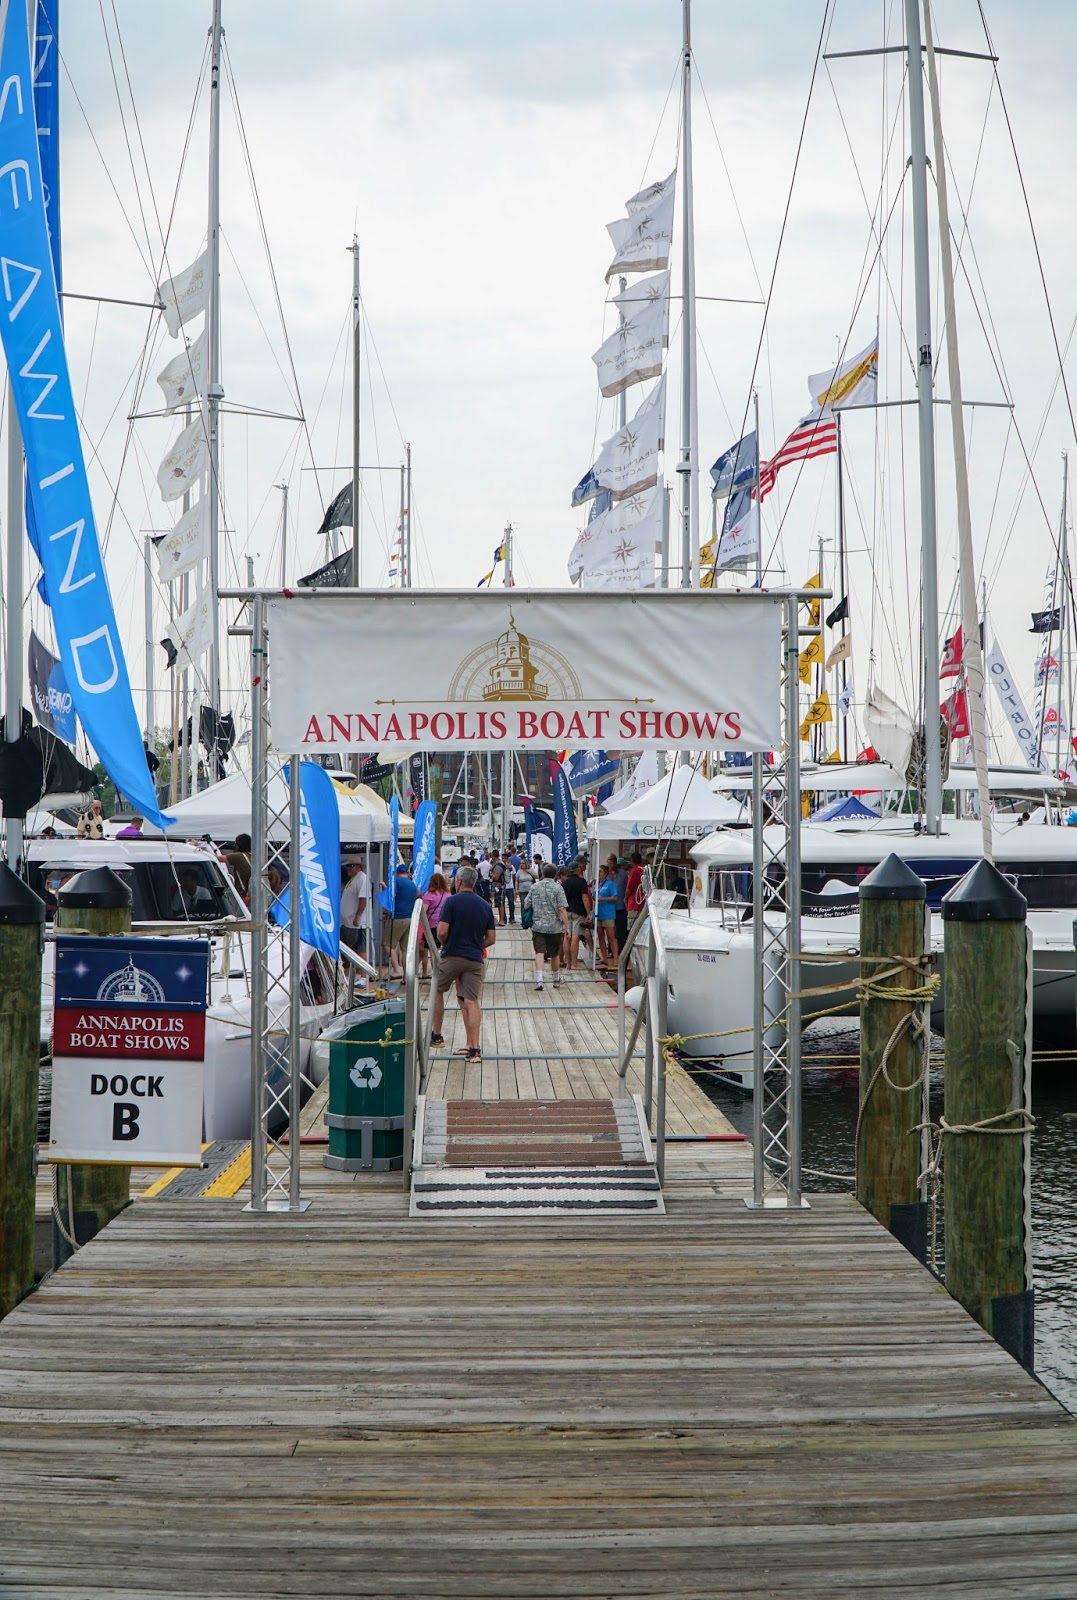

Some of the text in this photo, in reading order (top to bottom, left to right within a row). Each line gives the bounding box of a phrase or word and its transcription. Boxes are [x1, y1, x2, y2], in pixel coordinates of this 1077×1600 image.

[0, 74, 119, 695] SEAWIND
[302, 710, 742, 743] ANNAPOLIS BOAT SHOWS
[830, 813, 880, 822] ATLANTI
[556, 841, 566, 868] bout
[564, 831, 572, 861] YACHT
[76, 1015, 184, 1032] ANNAPOLIS
[69, 1033, 190, 1050] BOAT SHOWS
[90, 1074, 164, 1098] DOCK
[112, 1102, 140, 1141] B
